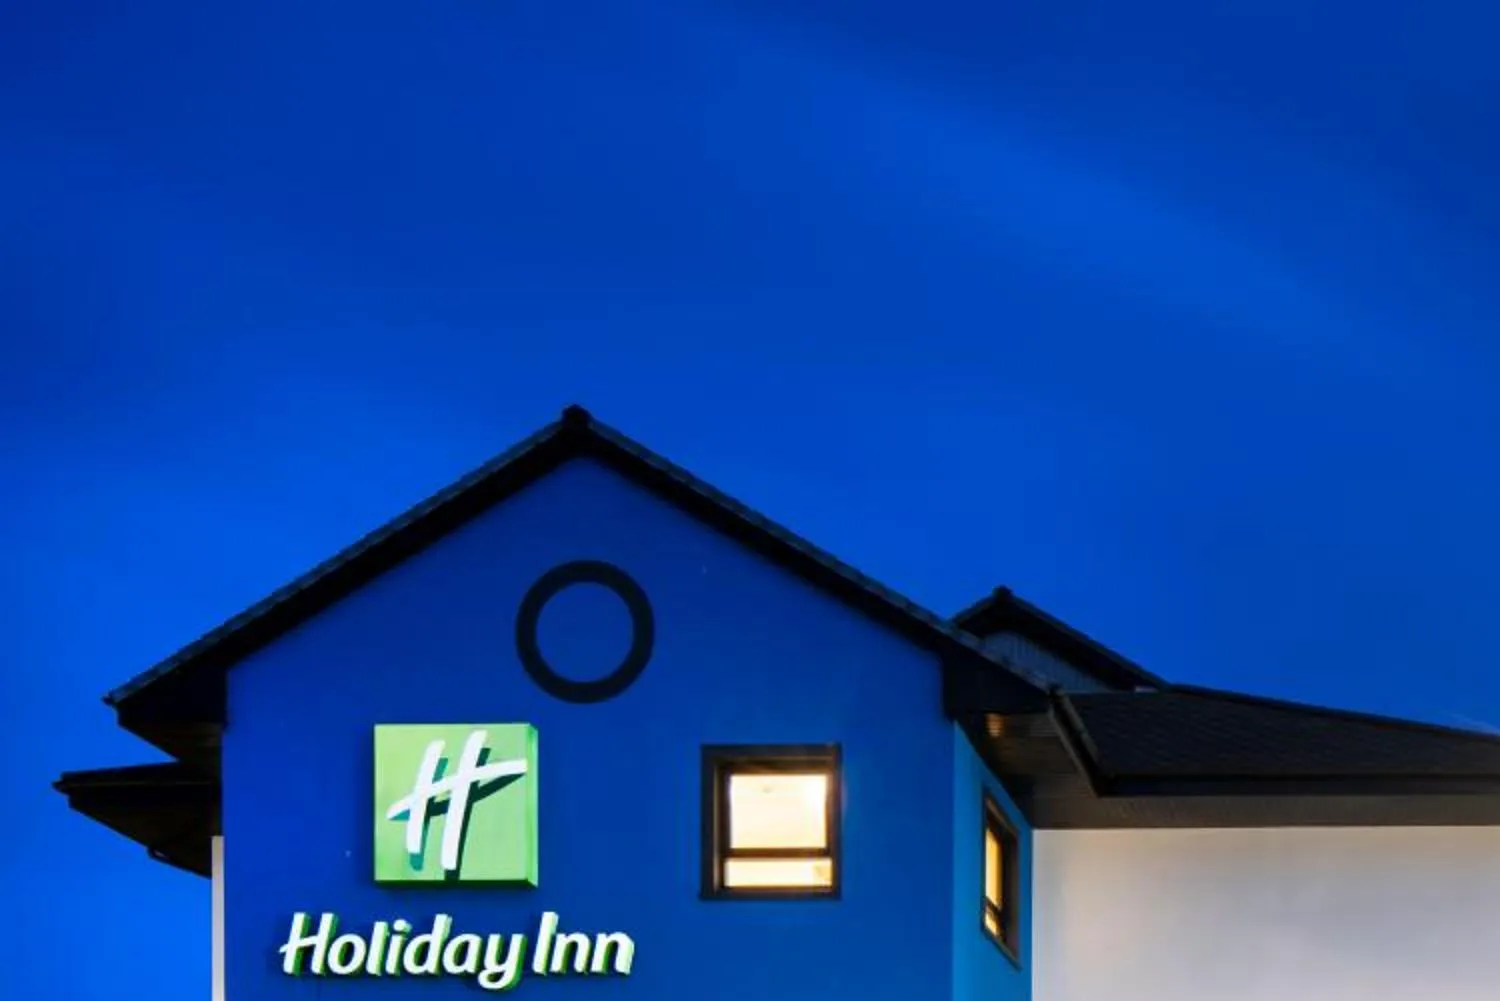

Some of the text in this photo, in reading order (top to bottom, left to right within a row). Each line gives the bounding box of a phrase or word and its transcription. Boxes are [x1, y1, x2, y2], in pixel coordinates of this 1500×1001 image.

[387, 730, 527, 870] H
[279, 911, 635, 989] Holiday Inn
